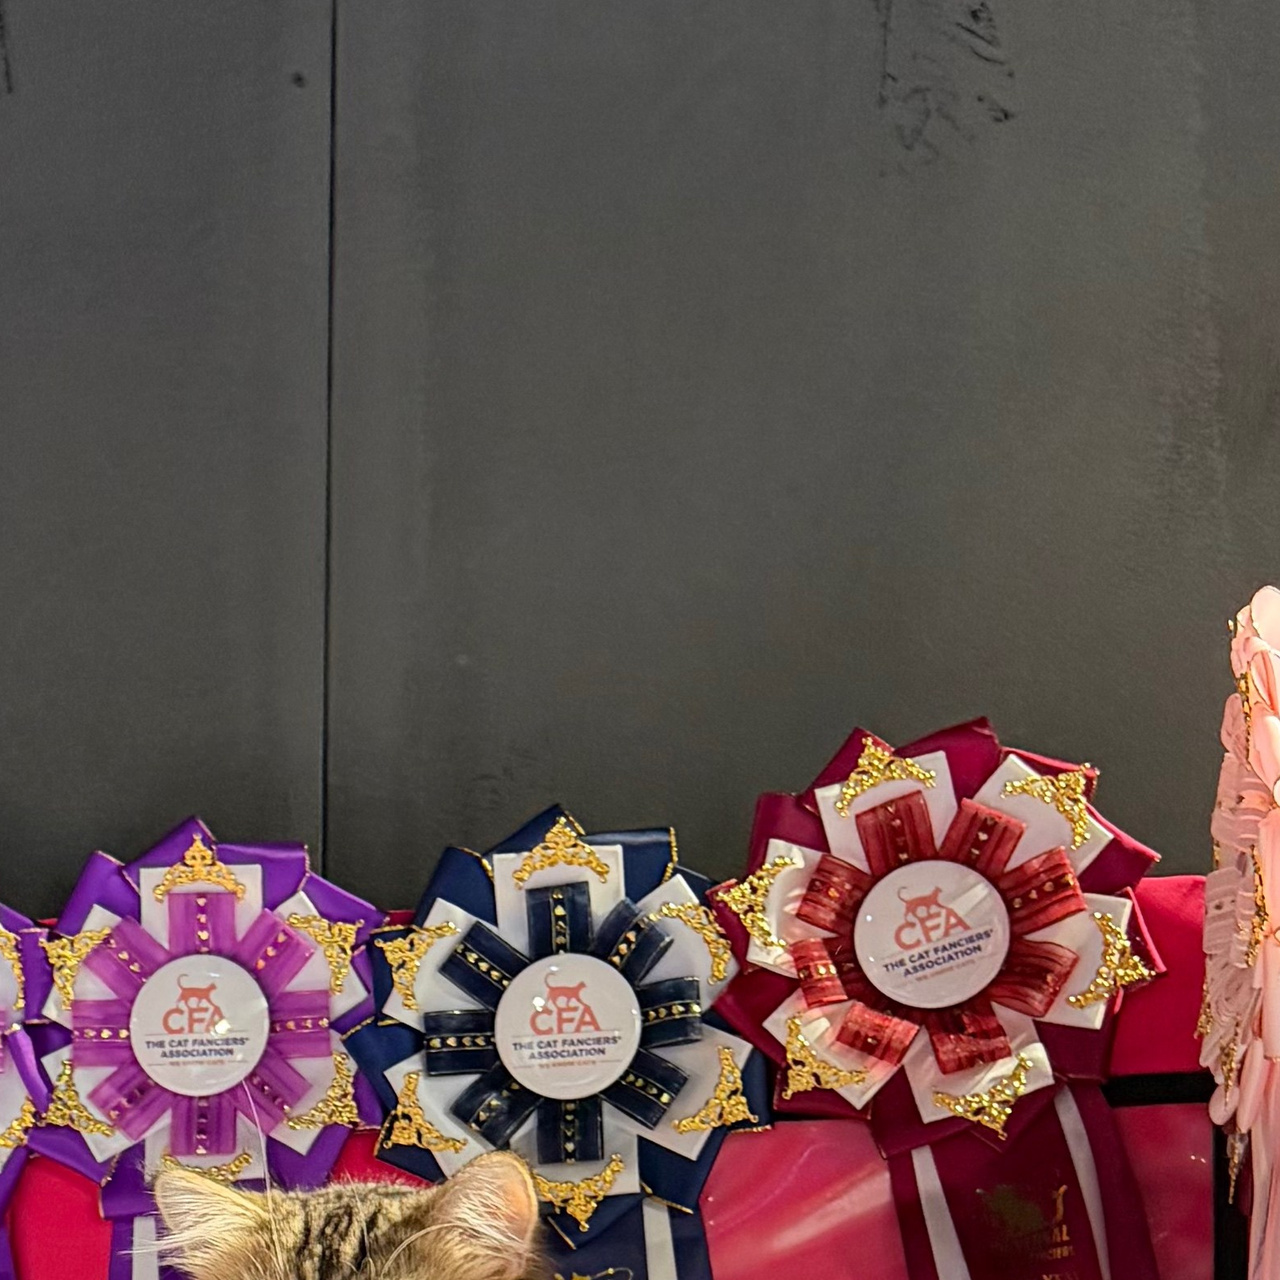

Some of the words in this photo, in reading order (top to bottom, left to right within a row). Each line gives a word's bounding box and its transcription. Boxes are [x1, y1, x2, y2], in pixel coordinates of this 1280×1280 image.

[894, 907, 972, 951] CFA
[883, 958, 907, 973] THE
[908, 949, 931, 964] CAT
[903, 943, 983, 978] ASSOCIATION
[162, 1006, 230, 1036] CFA
[529, 1005, 603, 1036] CFA
[145, 1039, 166, 1049] THE
[168, 1038, 189, 1048] CAT
[160, 1048, 235, 1059] ASSOCIATION
[512, 1041, 535, 1051] THE
[536, 1039, 559, 1050] CAT
[528, 1047, 606, 1060] ASSOCIATION
